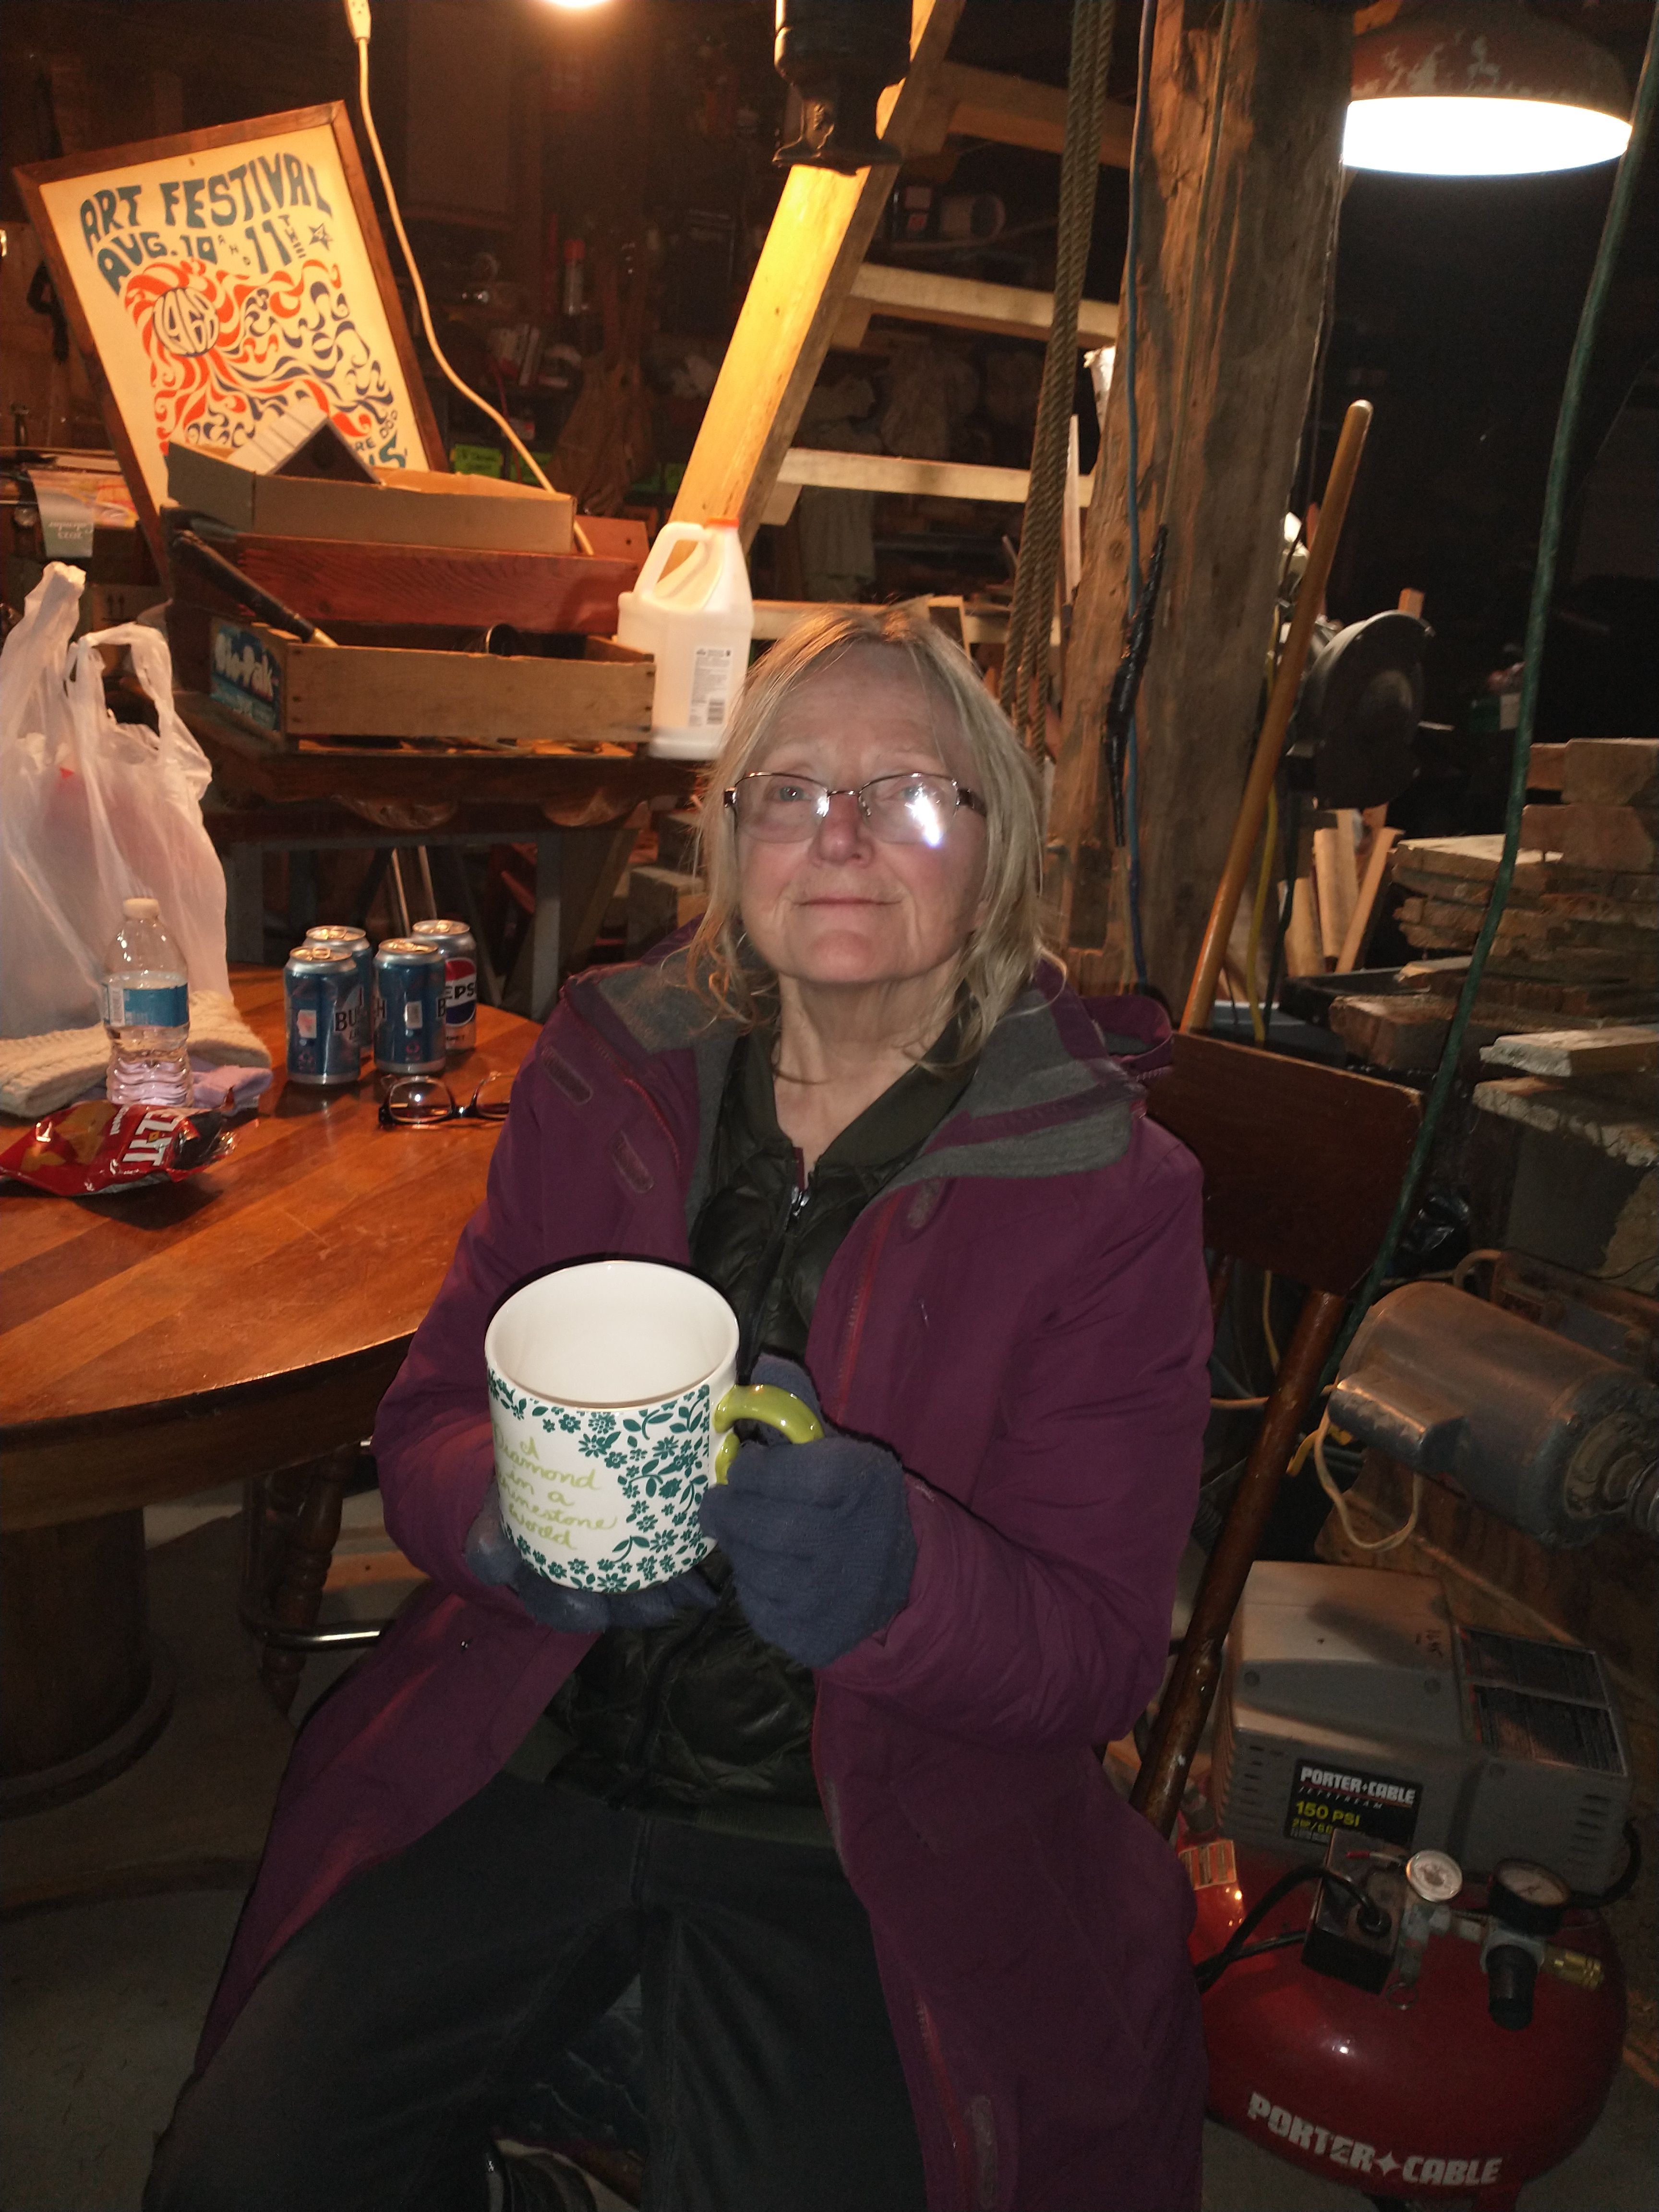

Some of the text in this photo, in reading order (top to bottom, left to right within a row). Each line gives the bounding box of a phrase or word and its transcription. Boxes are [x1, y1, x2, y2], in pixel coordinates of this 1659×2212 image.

[80, 152, 334, 255] ART FESTIVAL
[180, 234, 218, 265] 10
[153, 288, 219, 355] 1968
[547, 1491, 576, 1507] a
[1296, 1800, 1360, 1827] 150 PSI
